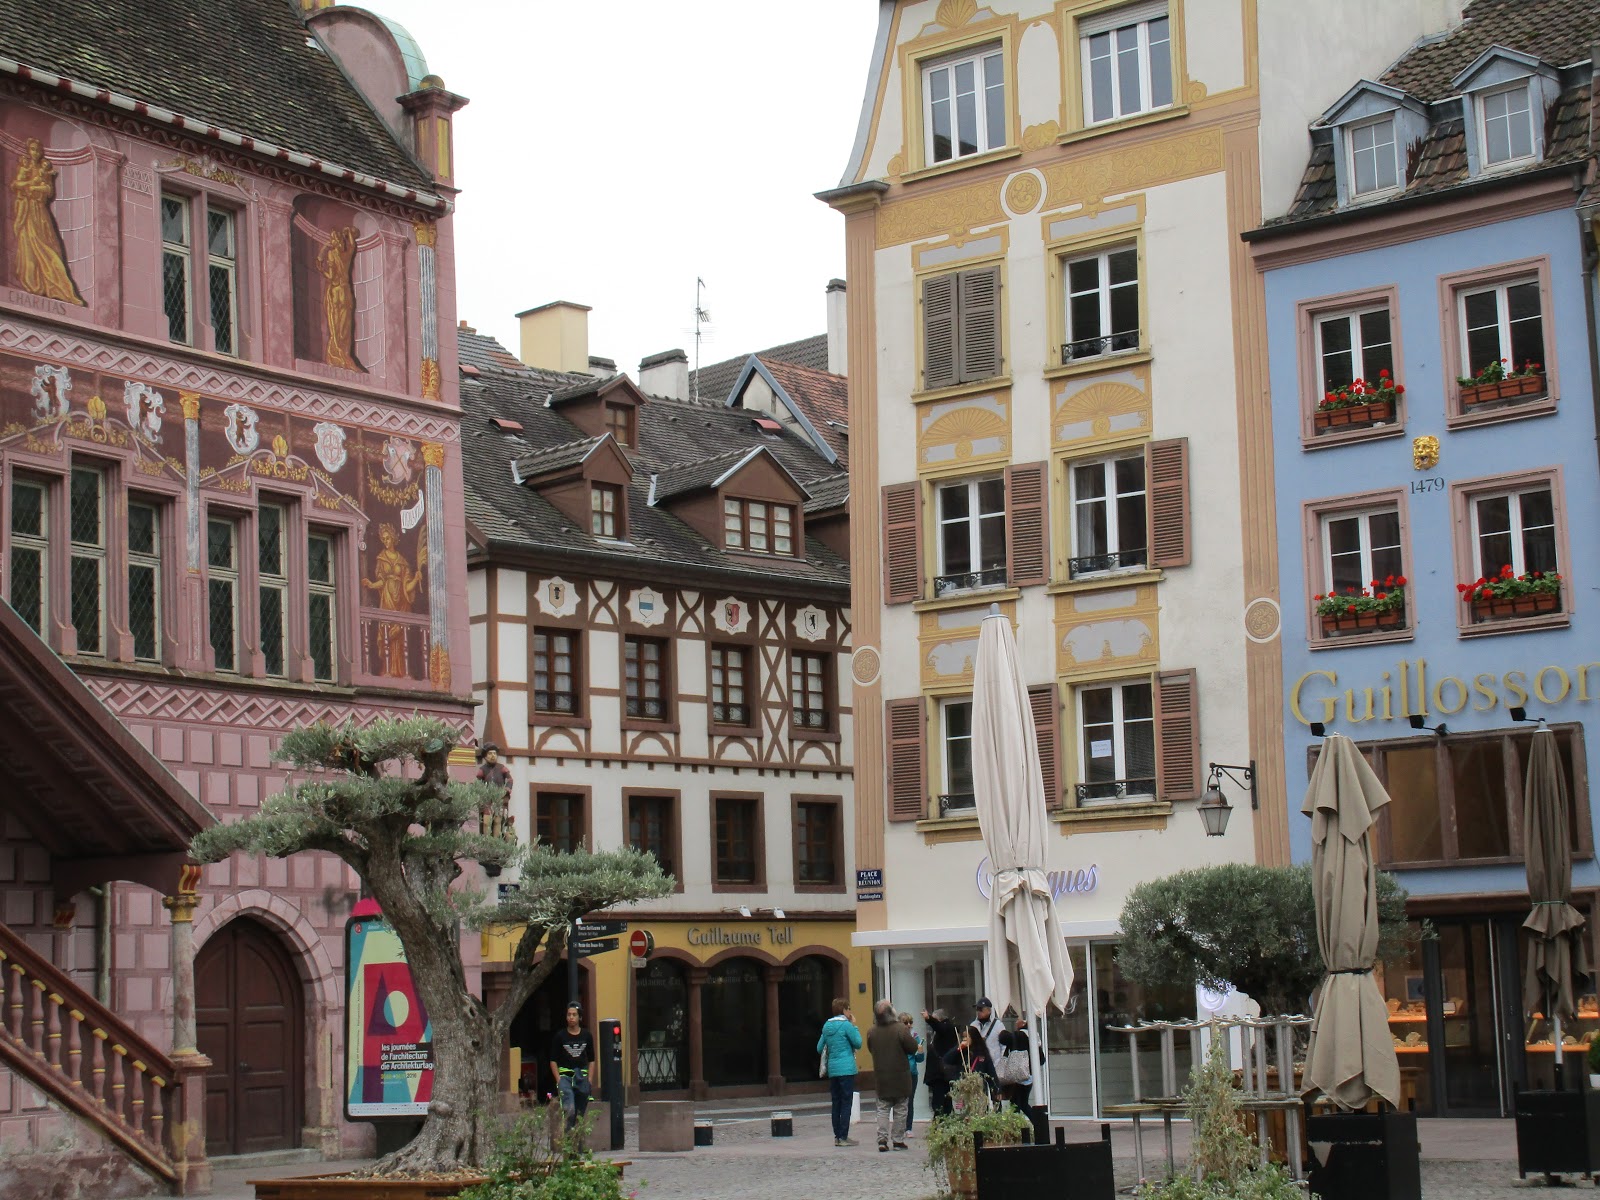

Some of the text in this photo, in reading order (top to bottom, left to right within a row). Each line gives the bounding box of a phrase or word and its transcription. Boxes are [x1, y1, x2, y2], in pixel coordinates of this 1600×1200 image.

[8, 290, 67, 316] CHARITAS
[1411, 477, 1445, 494] 1479
[1290, 657, 1600, 726] Guillosson
[688, 926, 794, 946] Guillaume Tell
[390, 1052, 427, 1060] l'architecture
[391, 1043, 416, 1052] journées
[381, 1062, 433, 1070] die Architekturtag
